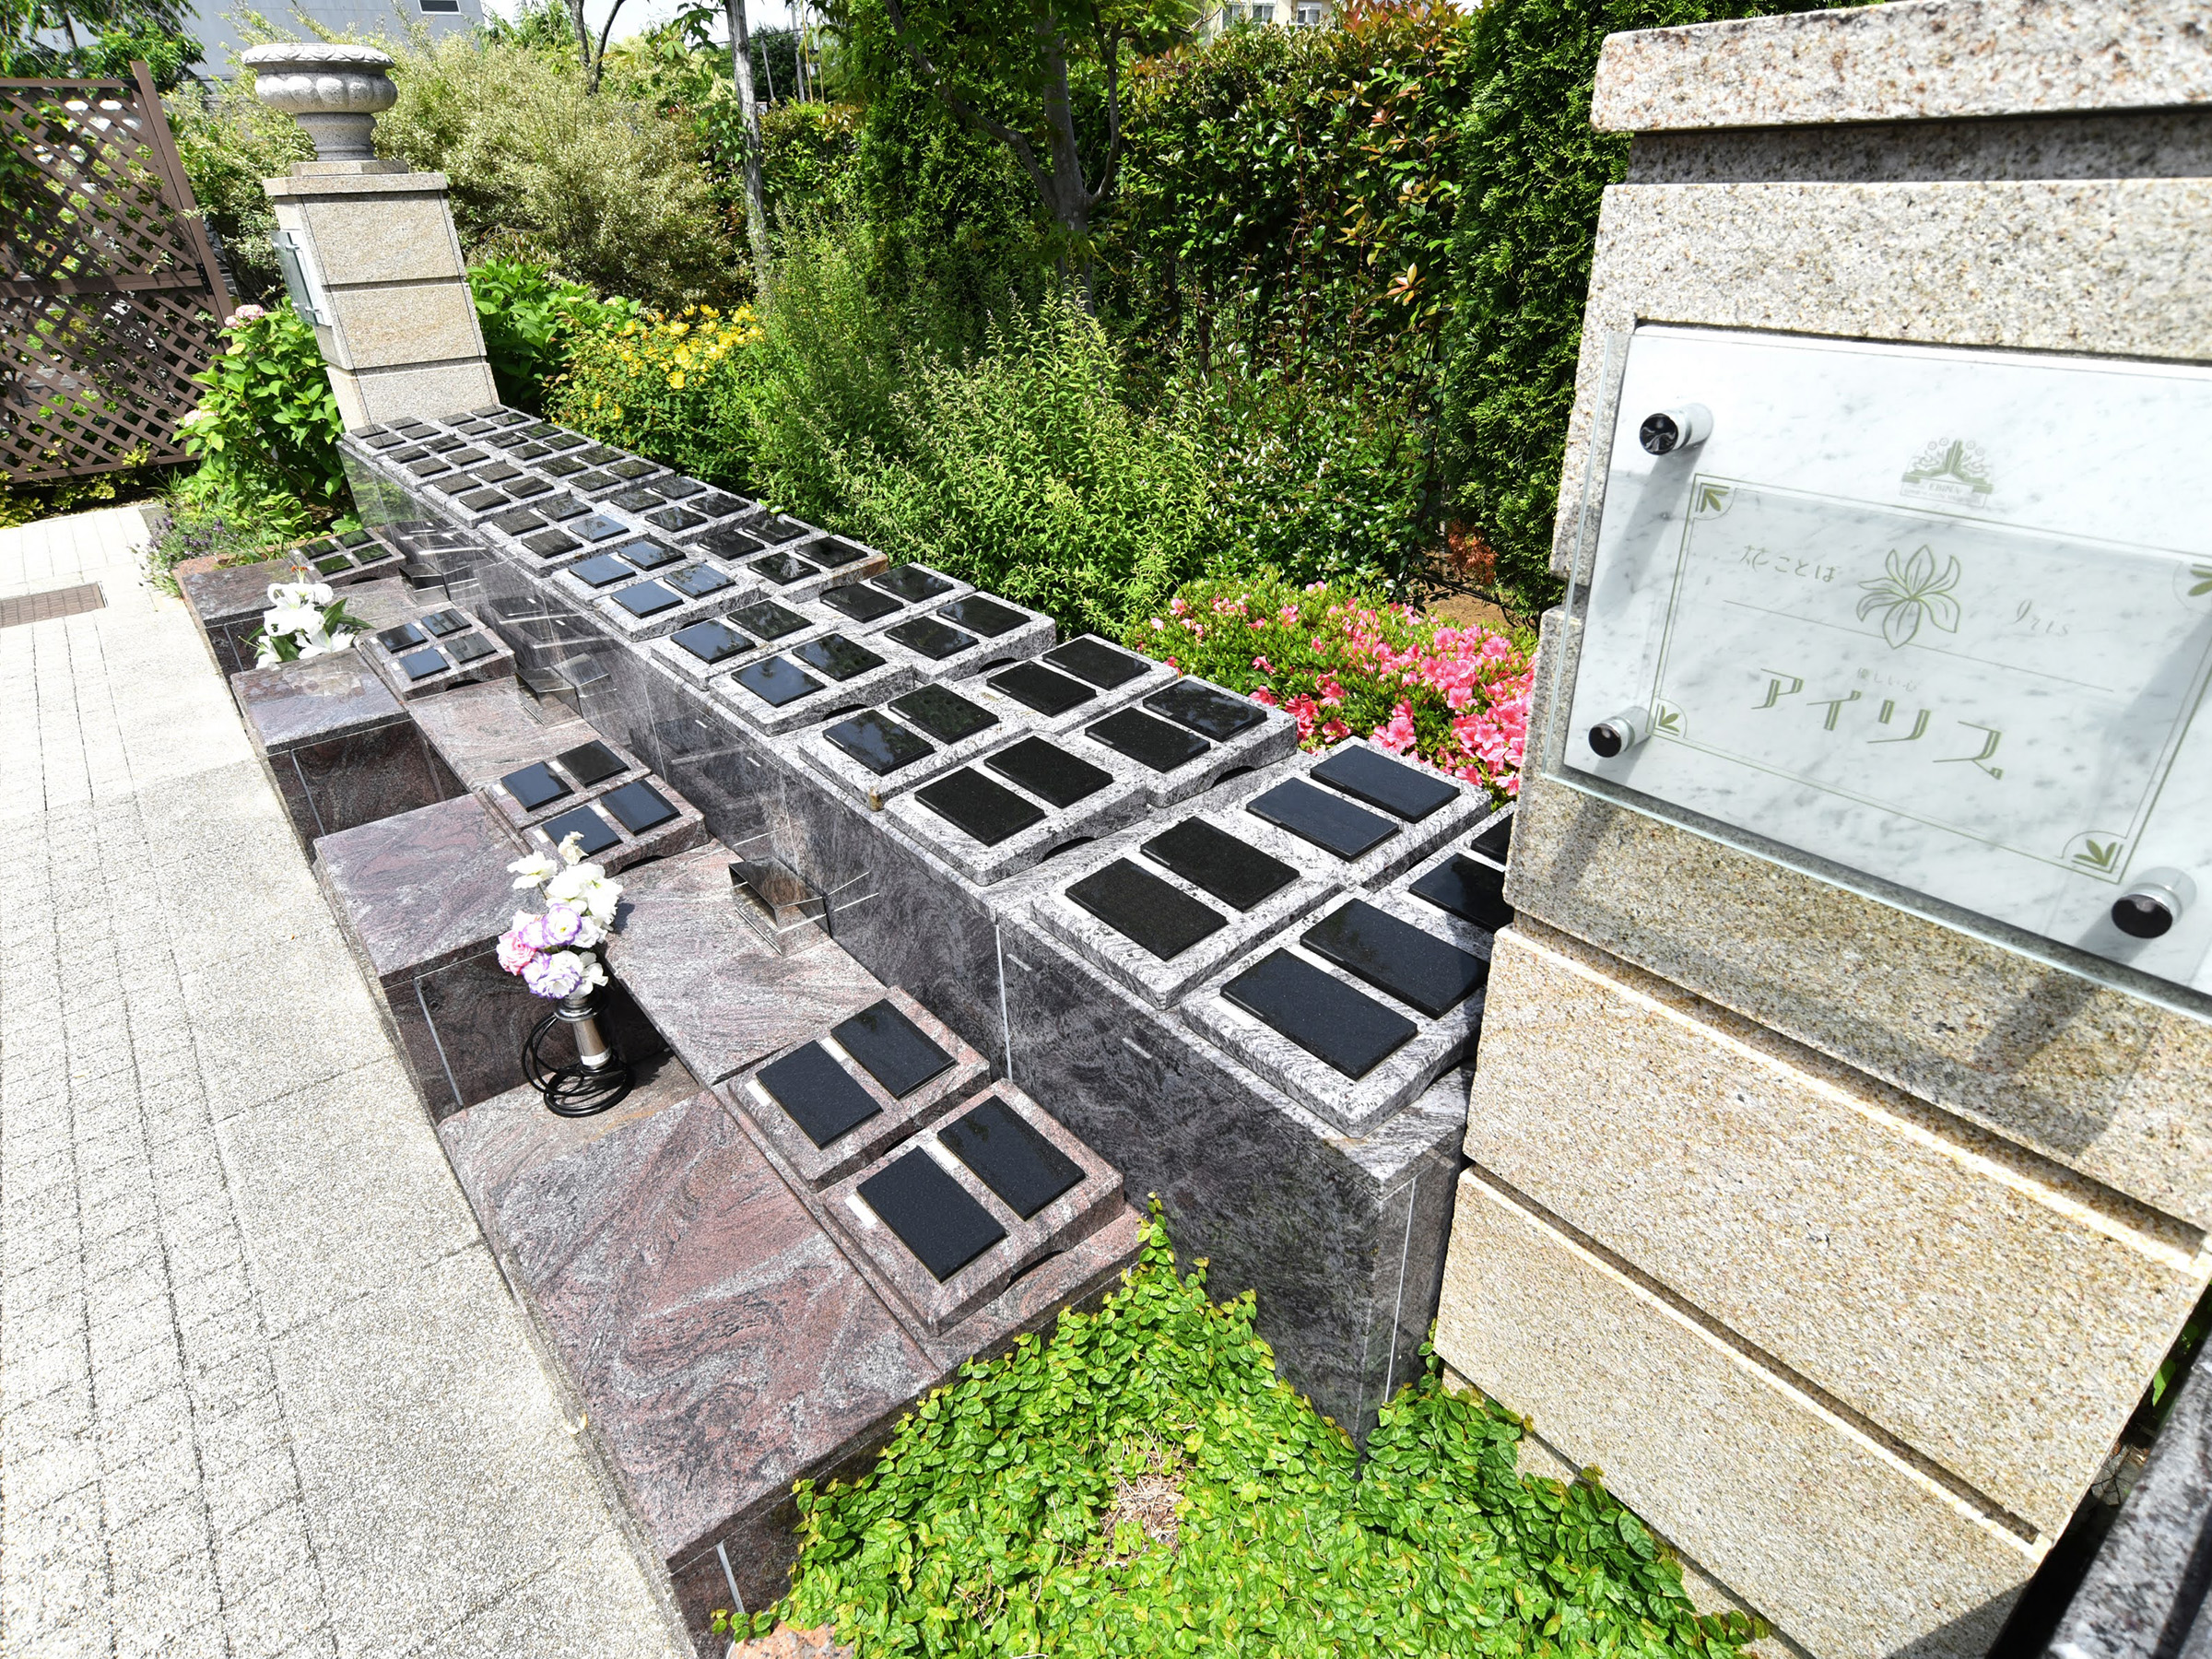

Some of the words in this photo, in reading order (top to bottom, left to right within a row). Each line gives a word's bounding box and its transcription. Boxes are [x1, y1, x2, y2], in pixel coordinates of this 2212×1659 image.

[1740, 545, 1841, 582] 花ことば
[1750, 668, 2003, 780] アイリス
